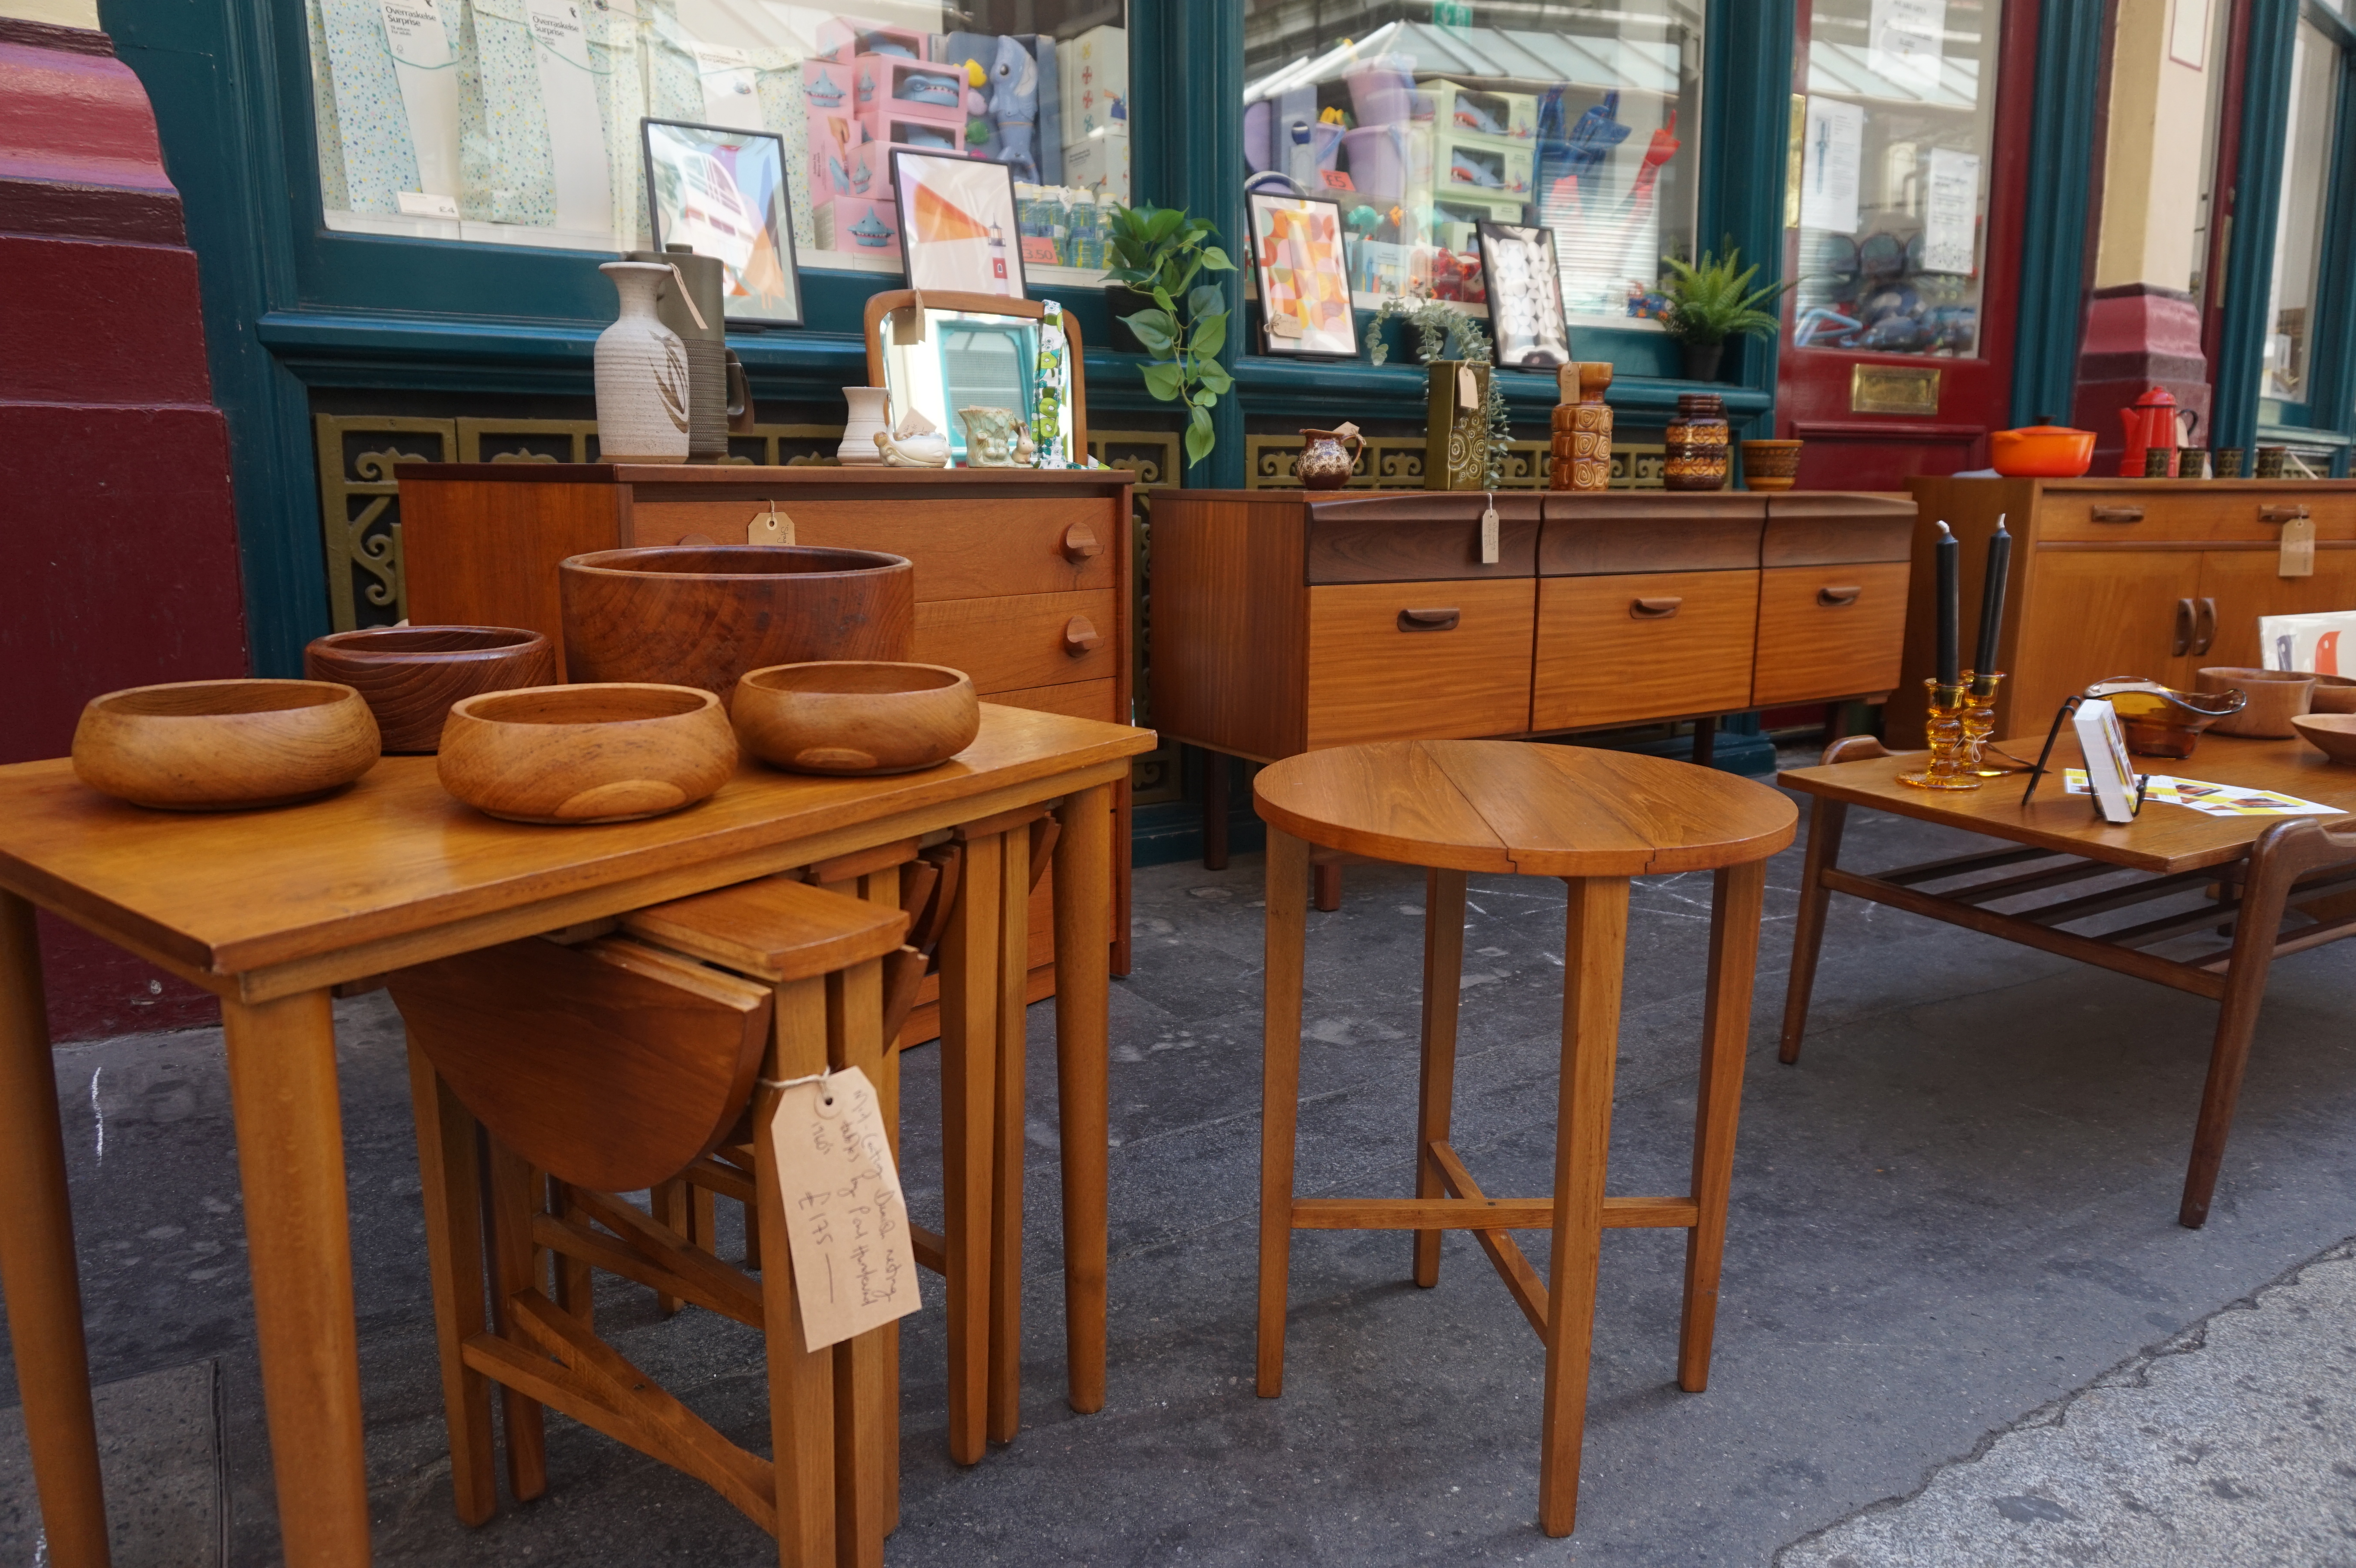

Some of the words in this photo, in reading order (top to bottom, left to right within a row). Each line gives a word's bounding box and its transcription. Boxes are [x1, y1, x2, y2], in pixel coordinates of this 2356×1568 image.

[386, 6, 437, 21] Overraskelse
[388, 15, 421, 26] Surprise
[533, 16, 580, 32] Overraskelse
[535, 24, 564, 37] Surprise
[1326, 175, 1346, 187] £5
[1023, 249, 1053, 259] 3.50
[840, 1119, 861, 1162] tables
[837, 1174, 863, 1198] by
[874, 1189, 896, 1240] Danish
[871, 1249, 902, 1302] nesting
